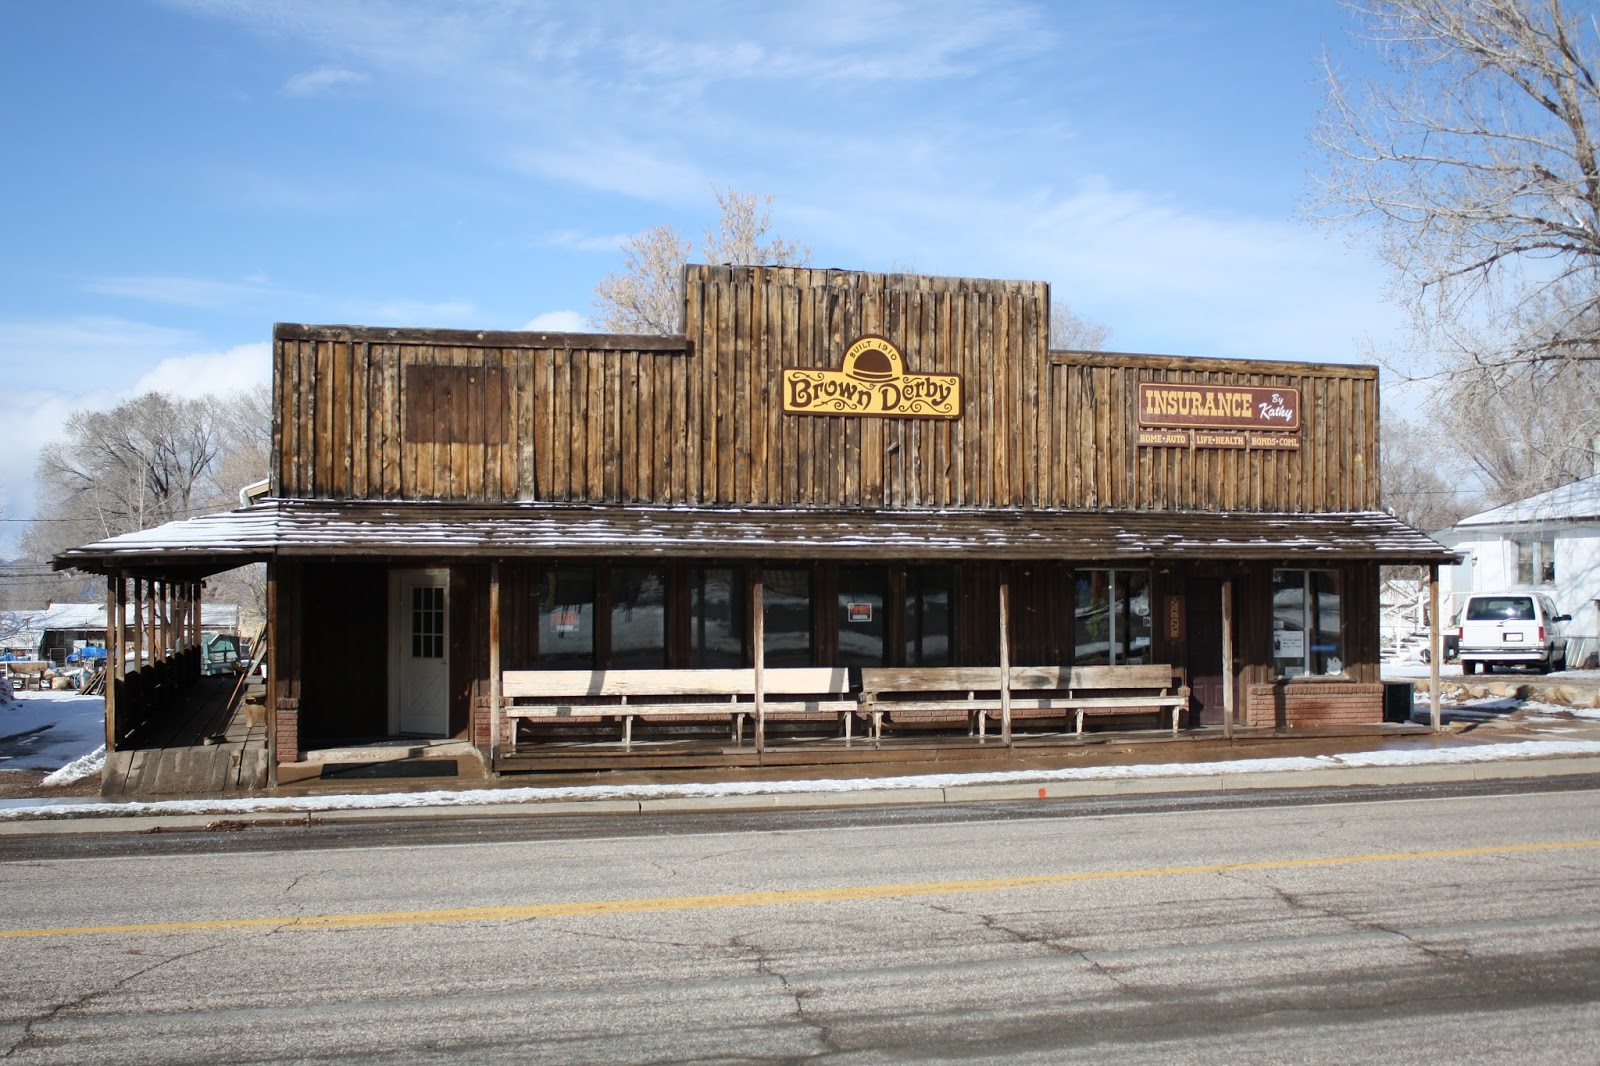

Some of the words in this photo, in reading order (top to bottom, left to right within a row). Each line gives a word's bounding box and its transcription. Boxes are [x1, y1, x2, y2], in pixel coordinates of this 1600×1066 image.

[849, 340, 872, 359] BUILT
[877, 341, 897, 362] 1910
[787, 375, 872, 411] Brown
[878, 376, 952, 411] Derby
[1145, 389, 1252, 418] INSURANCE
[1271, 393, 1284, 405] By
[1258, 402, 1293, 422] Kathy
